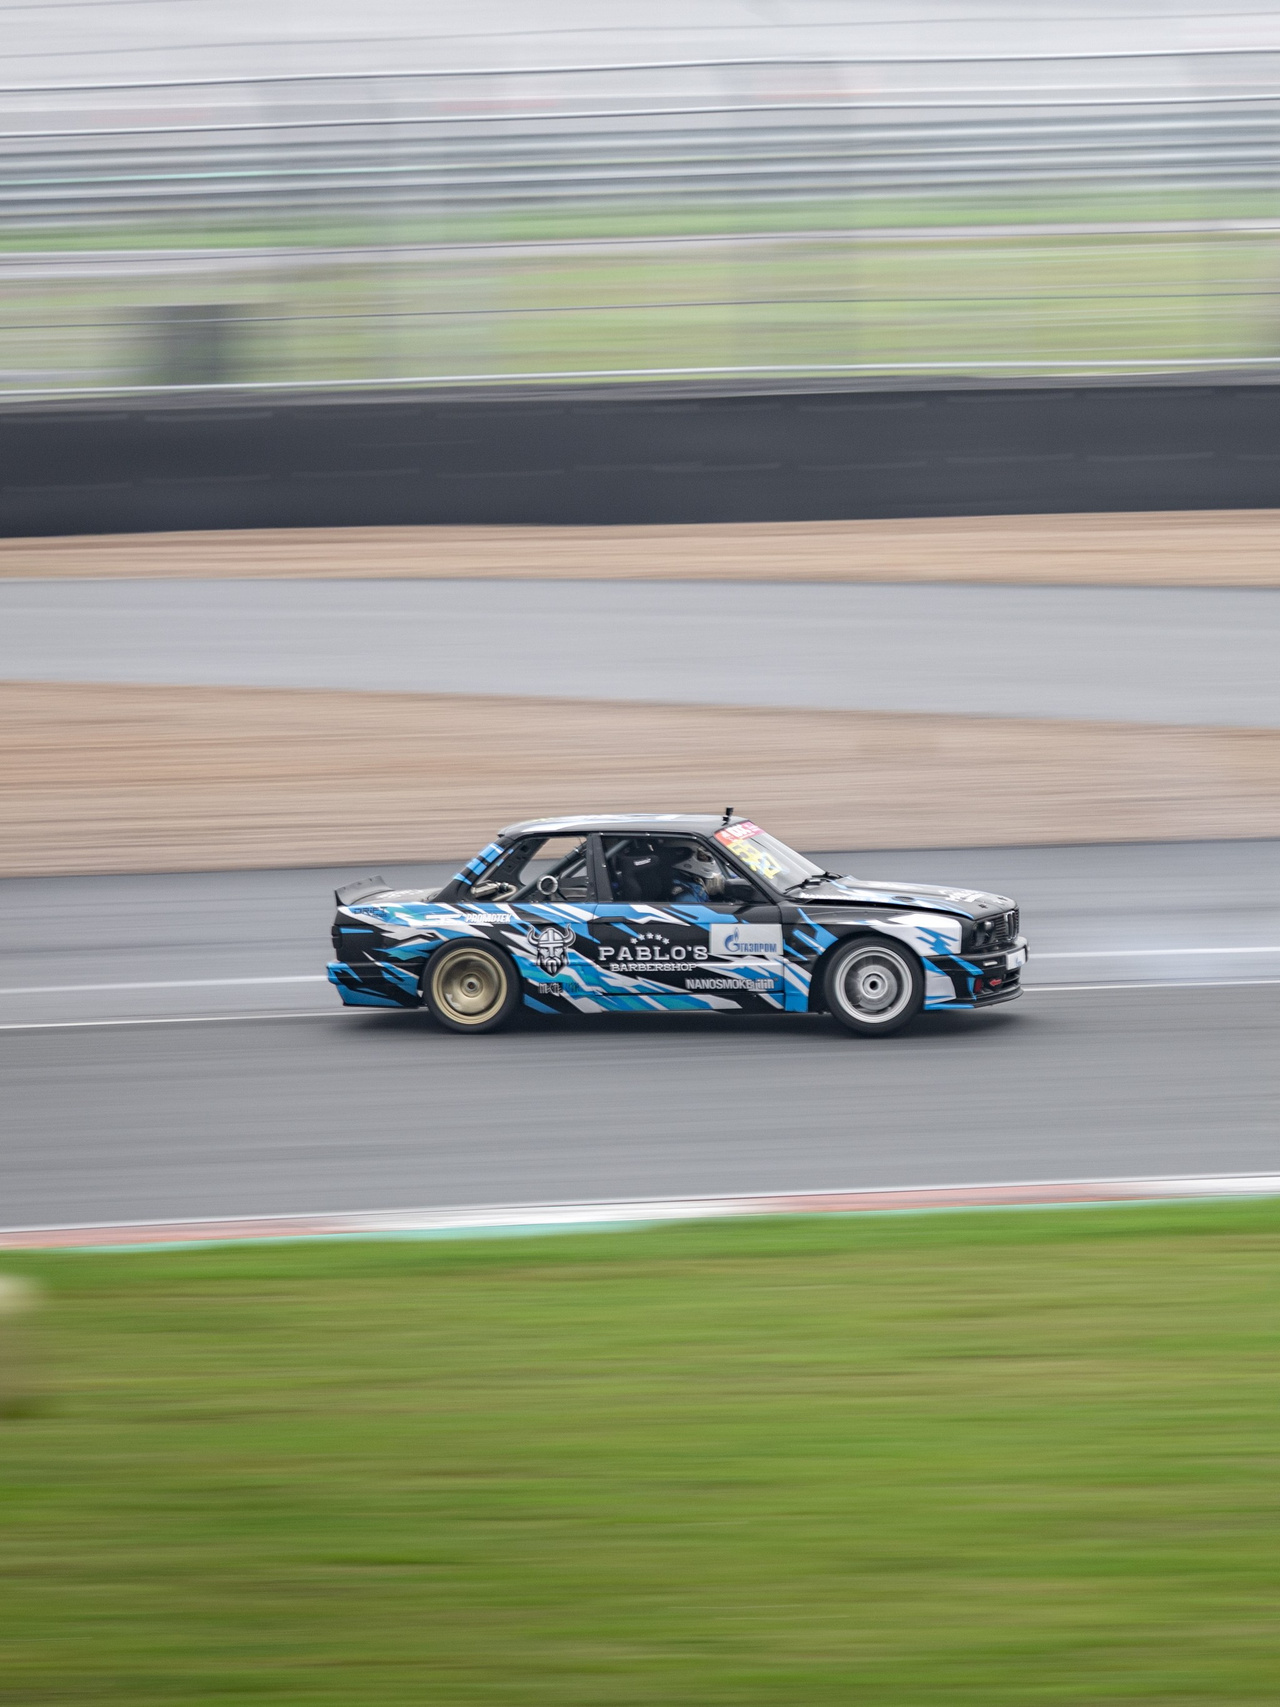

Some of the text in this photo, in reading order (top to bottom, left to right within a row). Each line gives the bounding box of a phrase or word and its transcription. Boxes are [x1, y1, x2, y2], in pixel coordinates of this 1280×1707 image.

[465, 913, 511, 924] PROMOTEK
[598, 945, 709, 961] PABLO'S
[740, 942, 777, 953] ГАЗПРОМ
[609, 962, 698, 972] BARBERSHOP
